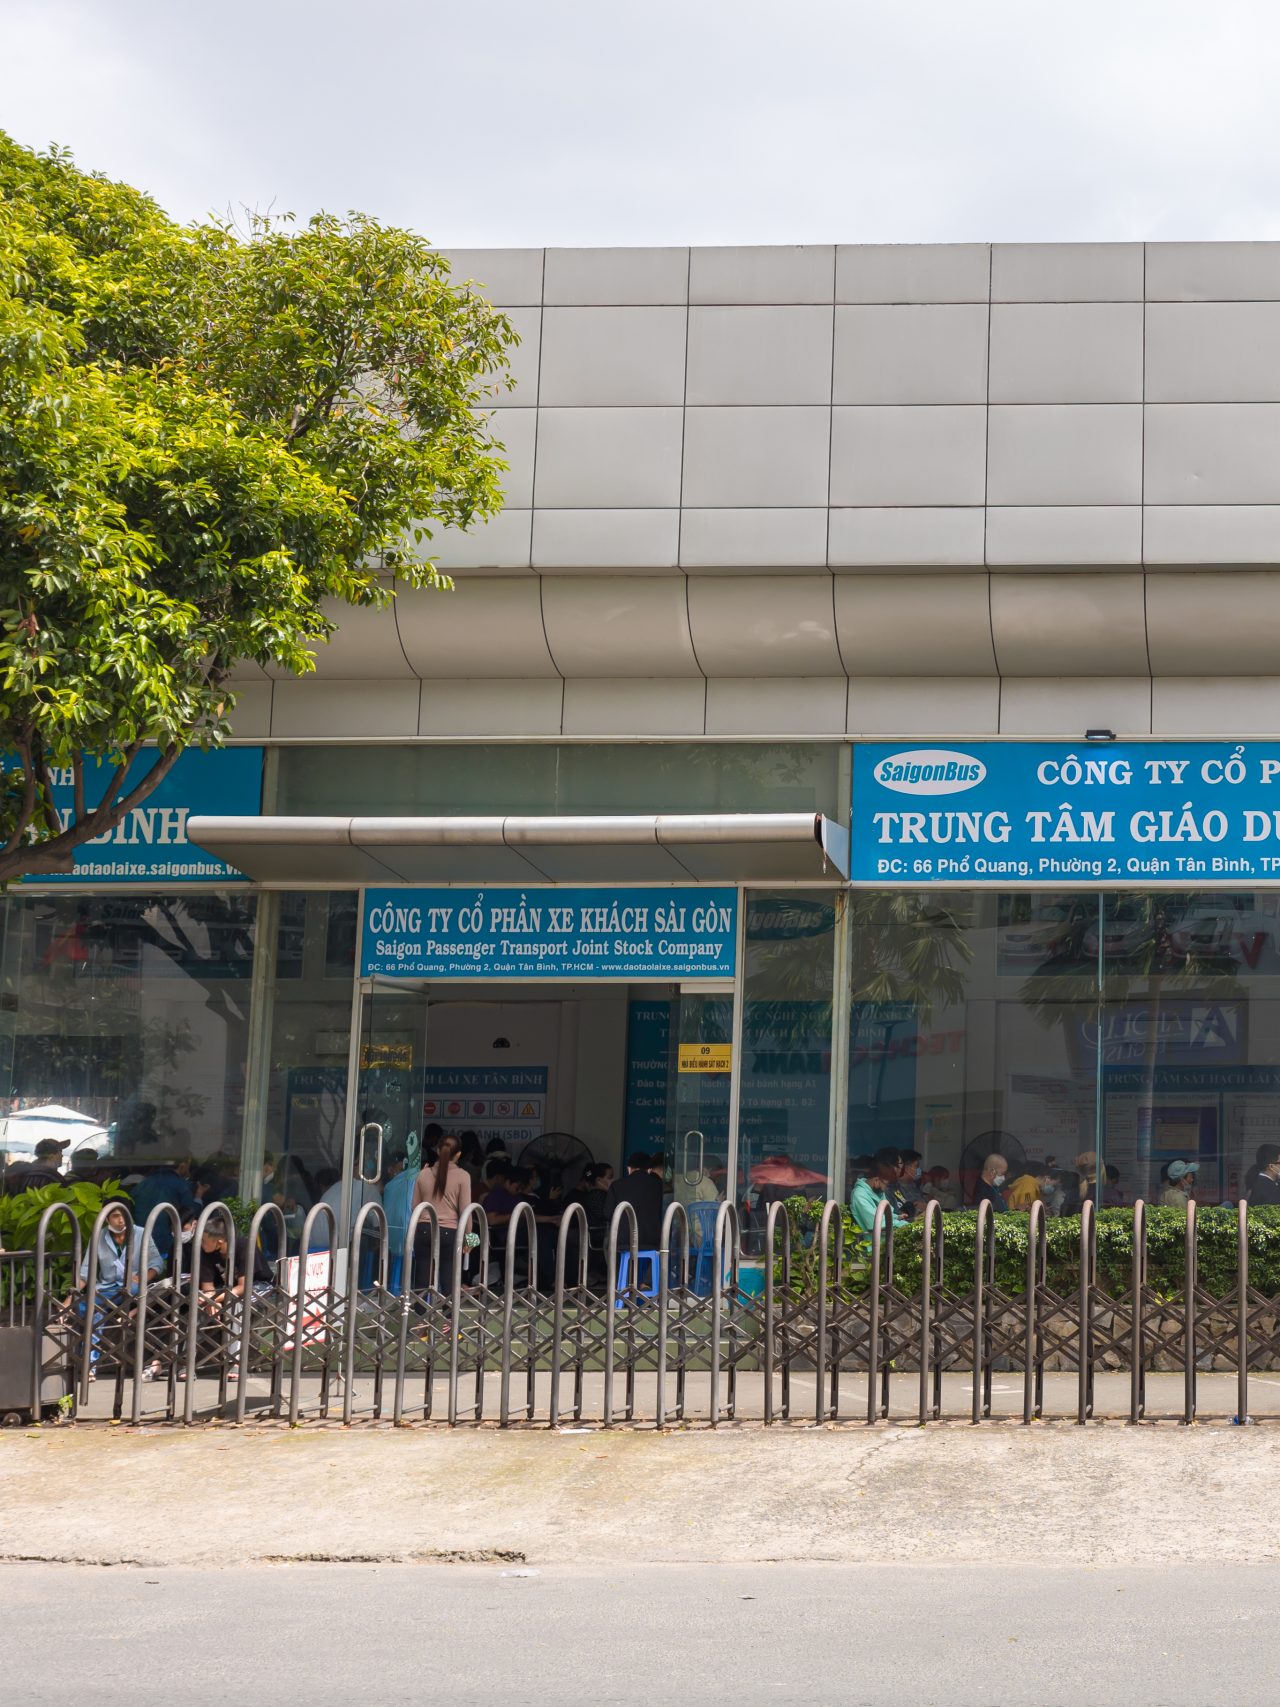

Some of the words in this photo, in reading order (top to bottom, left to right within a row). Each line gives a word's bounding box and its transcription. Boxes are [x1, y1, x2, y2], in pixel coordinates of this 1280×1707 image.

[880, 761, 980, 784] SaigonBus
[1037, 755, 1133, 785] CÔNG
[1144, 760, 1190, 784] TY
[1201, 746, 1247, 784] CỔ
[873, 812, 1012, 844] TRUNG
[1025, 802, 1116, 842] TÂM
[1129, 801, 1229, 843] GIÁO
[25, 861, 242, 877] aotaolaixe.saigonbus.v
[877, 858, 909, 874] ĐC:
[913, 859, 933, 874] 66
[937, 853, 970, 873] Phổ
[974, 858, 1034, 876] Quang,
[1039, 857, 1102, 876] Phường
[1107, 858, 1122, 875] 2,
[1126, 857, 1170, 876] Quận
[1175, 857, 1206, 872] Tân
[1212, 857, 1255, 874] Bình,
[369, 901, 422, 933] CÔNG
[428, 908, 453, 933] TY
[458, 893, 484, 933] CỔ
[489, 893, 542, 933] PHẦN
[547, 907, 574, 933] XE
[579, 900, 649, 933] KHÁCH
[654, 900, 686, 933] SÀI
[692, 900, 732, 933] GÒN
[376, 940, 422, 960] Saigon
[426, 940, 496, 960] Passenger
[500, 940, 568, 960] Transport
[572, 939, 609, 955] Joint
[614, 939, 653, 955] Stock
[658, 939, 723, 960] Company
[385, 963, 396, 971] 66
[398, 961, 415, 971] Phổ
[416, 963, 447, 972] Quang,
[449, 962, 482, 972] Phường
[484, 963, 491, 972] 2,
[493, 962, 516, 972] Quận
[518, 962, 534, 971] Tân
[536, 962, 559, 972] Bình,
[560, 962, 594, 971] TP.HCM
[601, 962, 730, 972] www.daotaolaixe.saigonbus.vn
[635, 1011, 670, 1021] TRUN
[700, 1046, 711, 1055] 09
